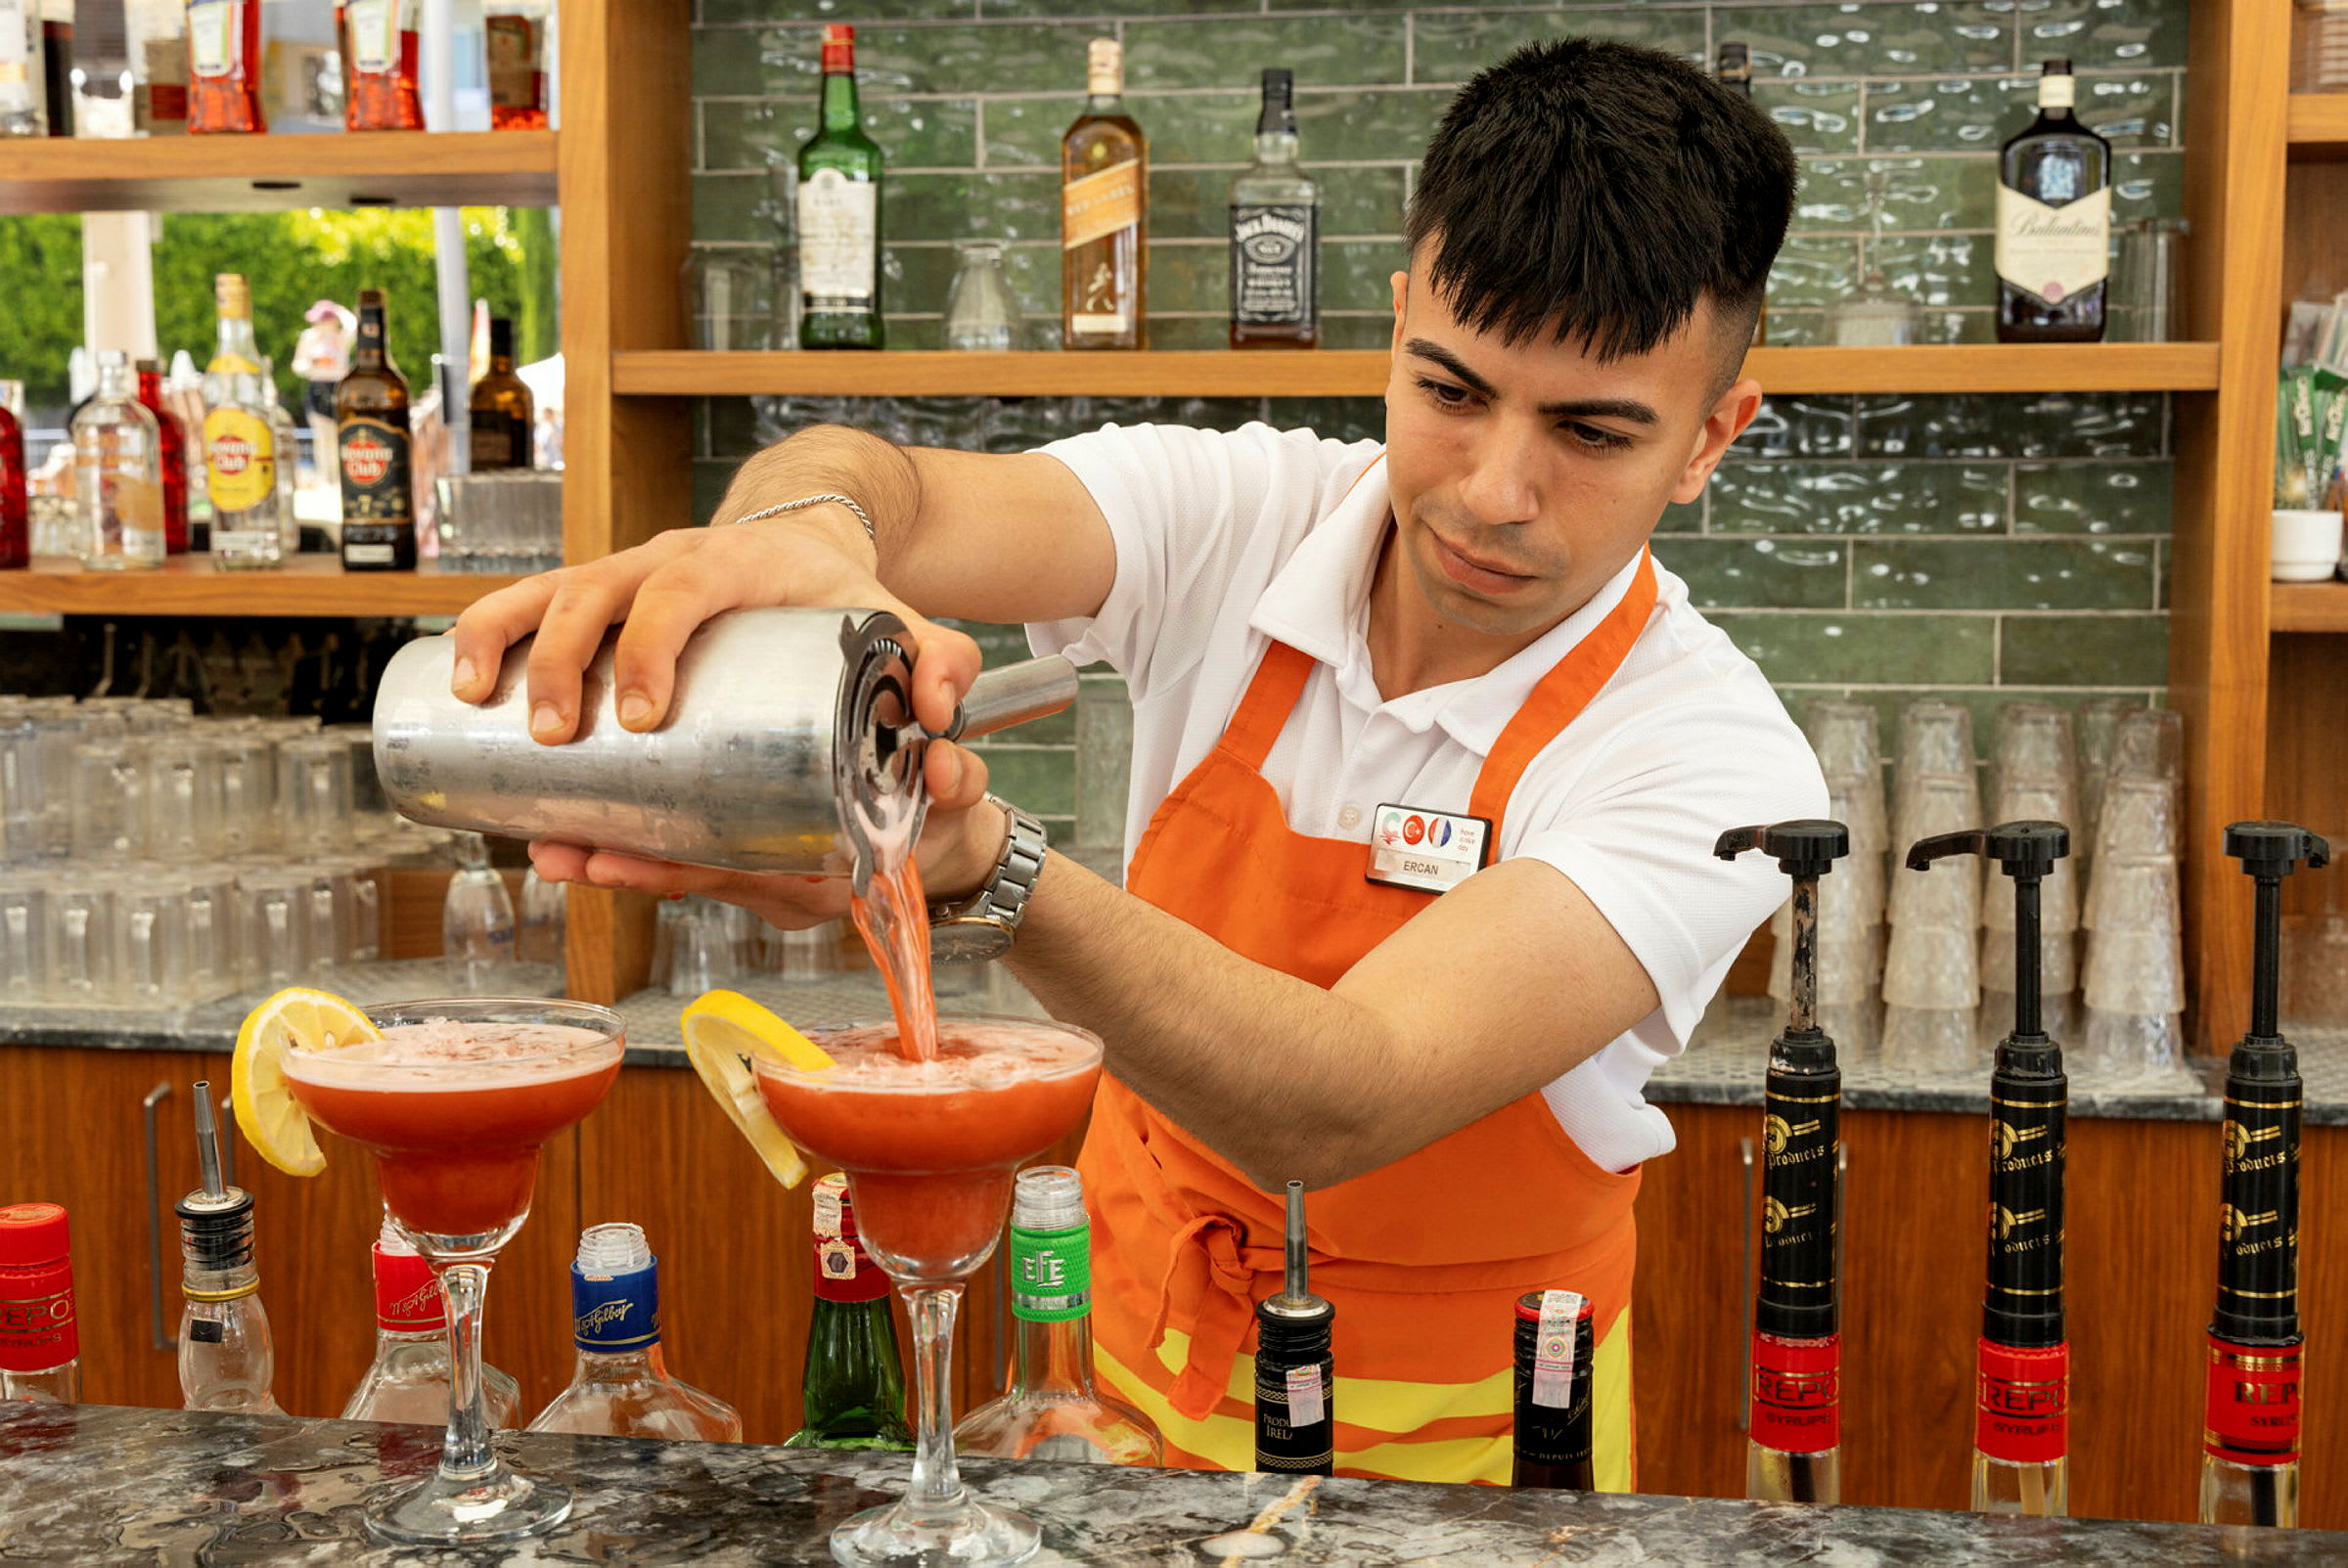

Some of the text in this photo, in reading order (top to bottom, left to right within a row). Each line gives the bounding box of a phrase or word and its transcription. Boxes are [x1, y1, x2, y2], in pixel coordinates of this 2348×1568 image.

[1403, 860, 1439, 875] ERCAN
[1022, 1250, 1065, 1288] EFE
[0, 1299, 69, 1326] EPO
